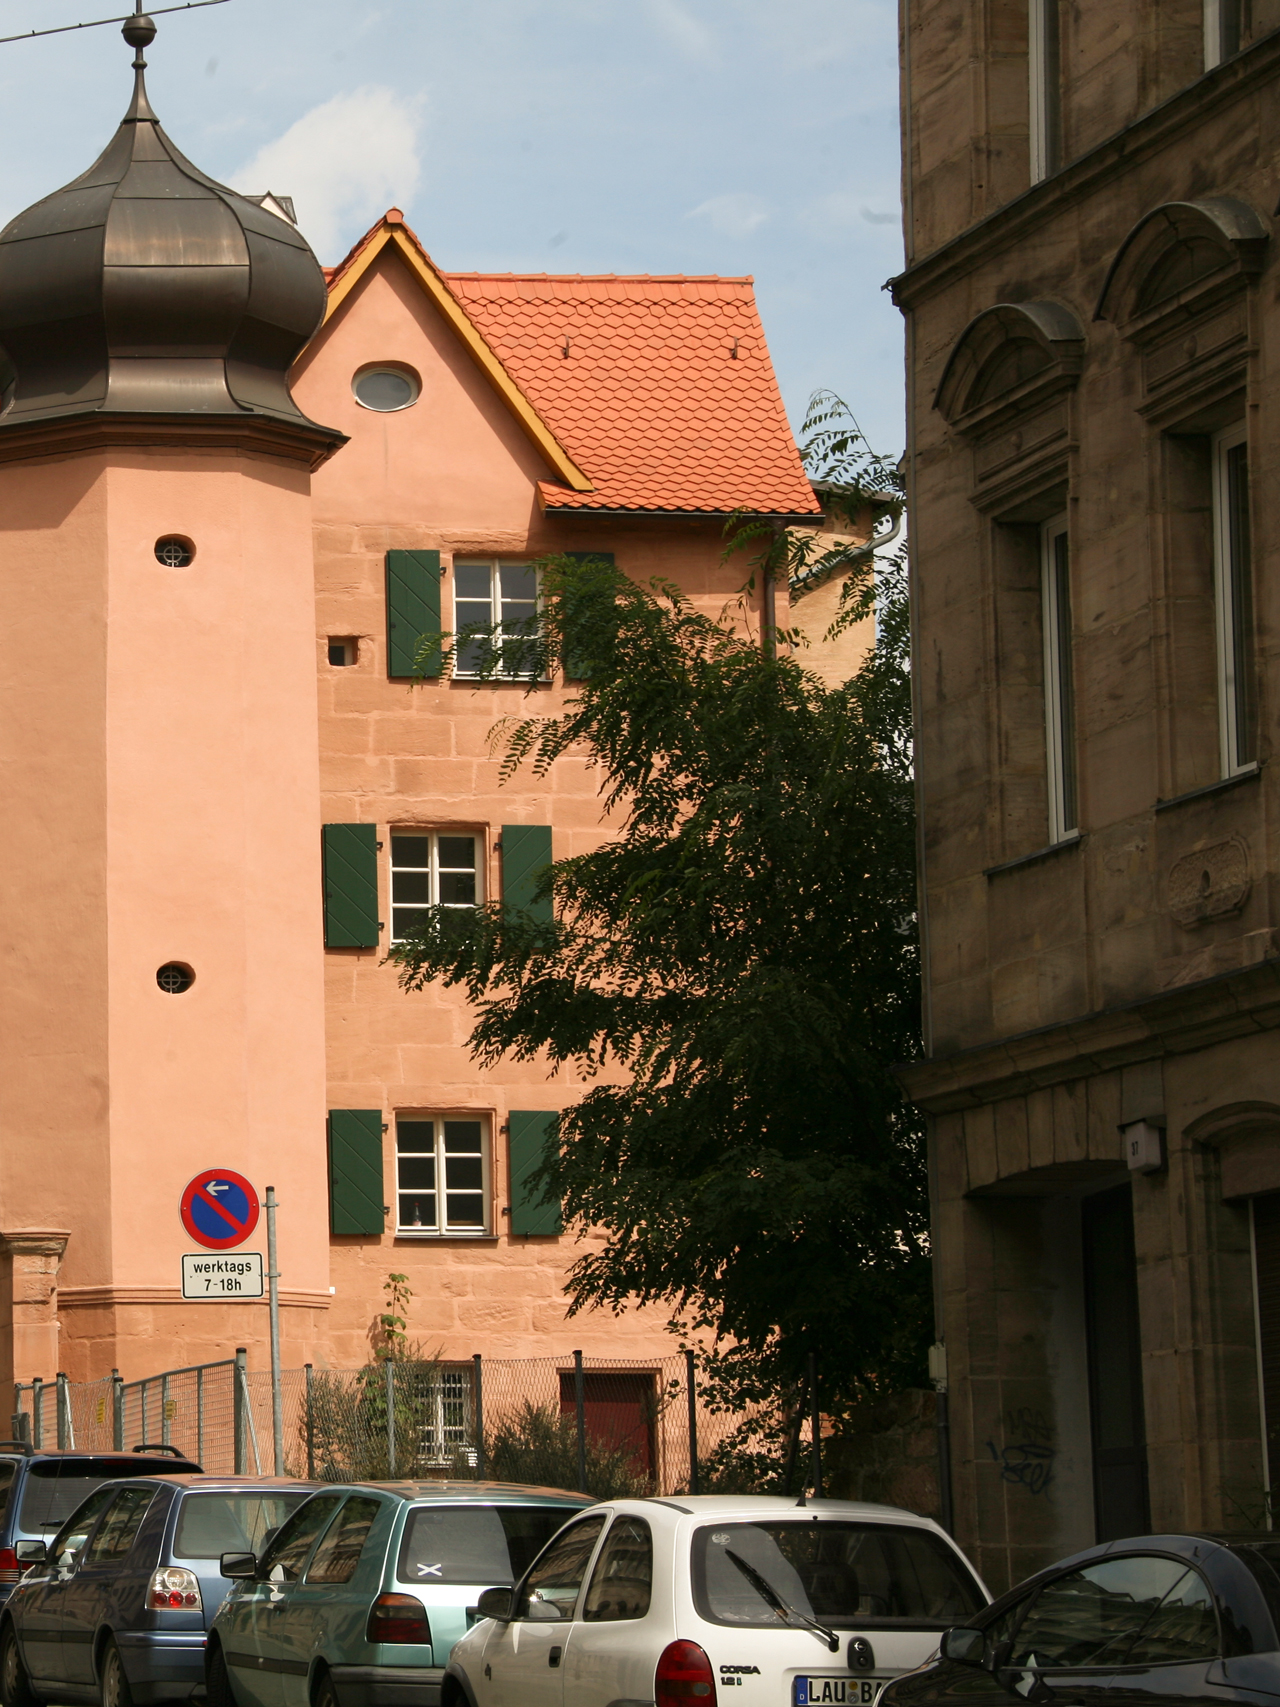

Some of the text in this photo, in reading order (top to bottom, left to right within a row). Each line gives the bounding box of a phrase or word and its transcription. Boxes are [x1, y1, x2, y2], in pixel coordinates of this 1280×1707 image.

[1131, 1141, 1138, 1156] 37
[193, 1260, 252, 1275] werktags
[204, 1278, 242, 1291] 7-18h
[719, 1665, 761, 1675] CORSA
[809, 1681, 846, 1703] LAU
